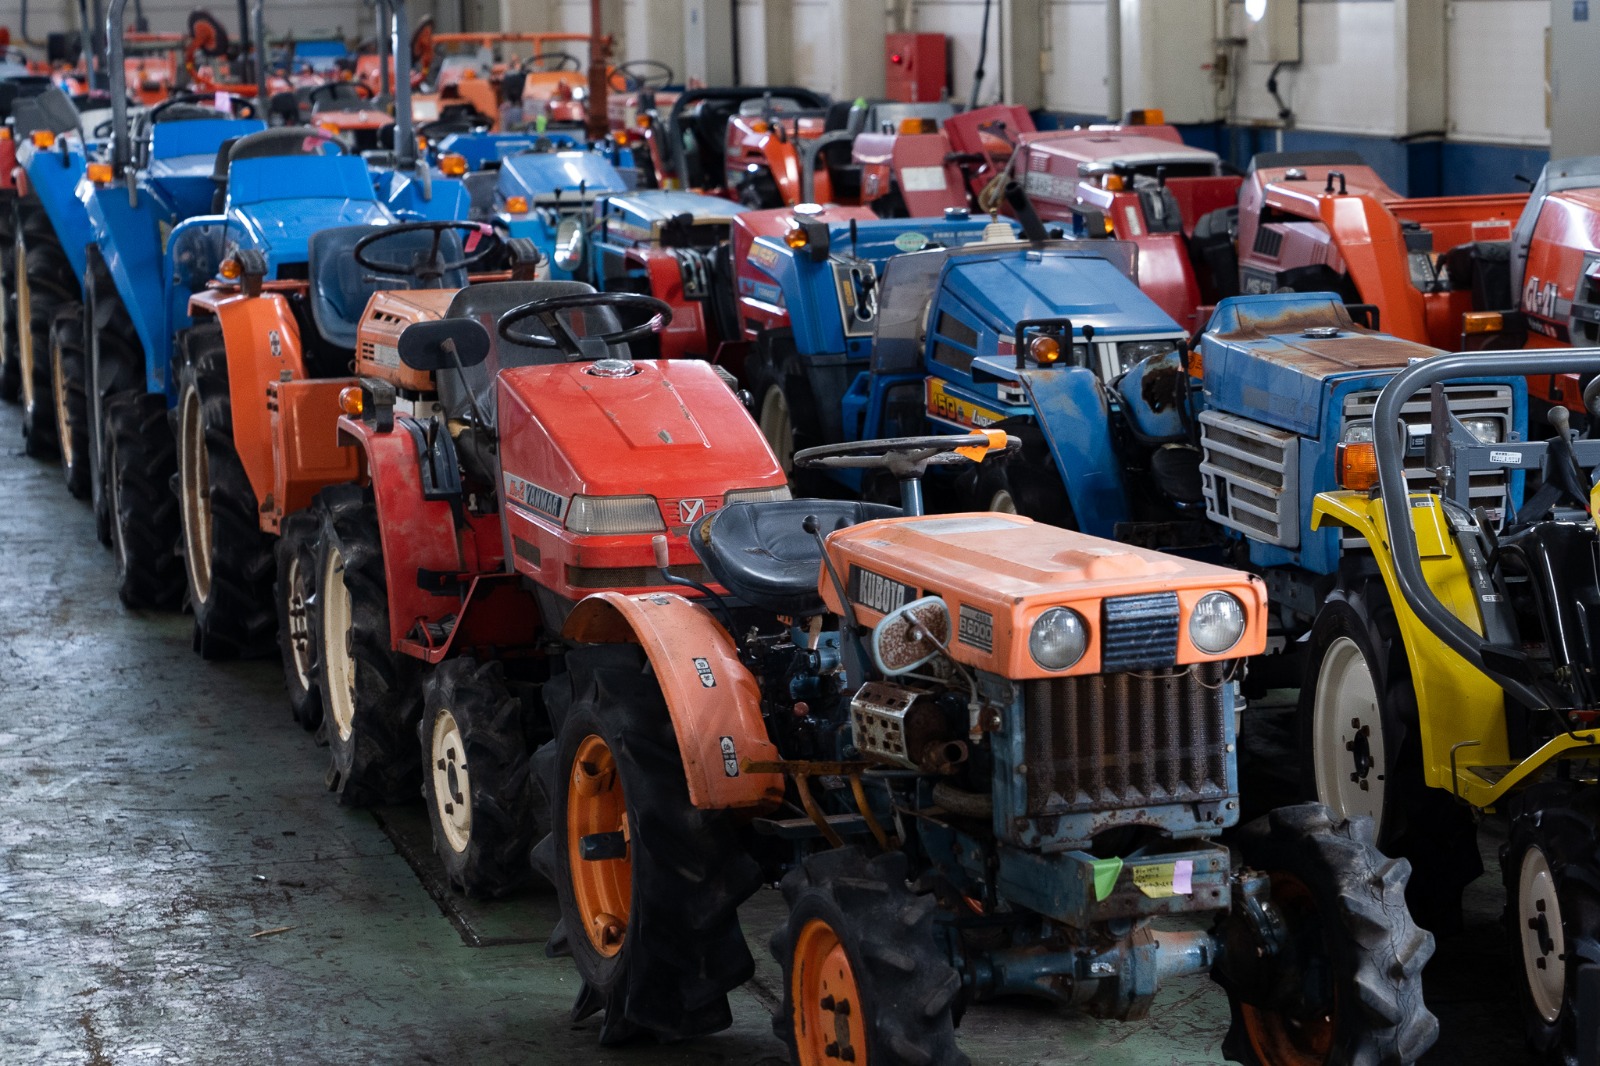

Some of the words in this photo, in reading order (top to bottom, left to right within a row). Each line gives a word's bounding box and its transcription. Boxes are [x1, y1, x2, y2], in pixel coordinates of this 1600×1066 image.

[526, 483, 562, 519] YANMAR
[859, 569, 906, 613] KUBOTA
[960, 617, 993, 641] B6000
